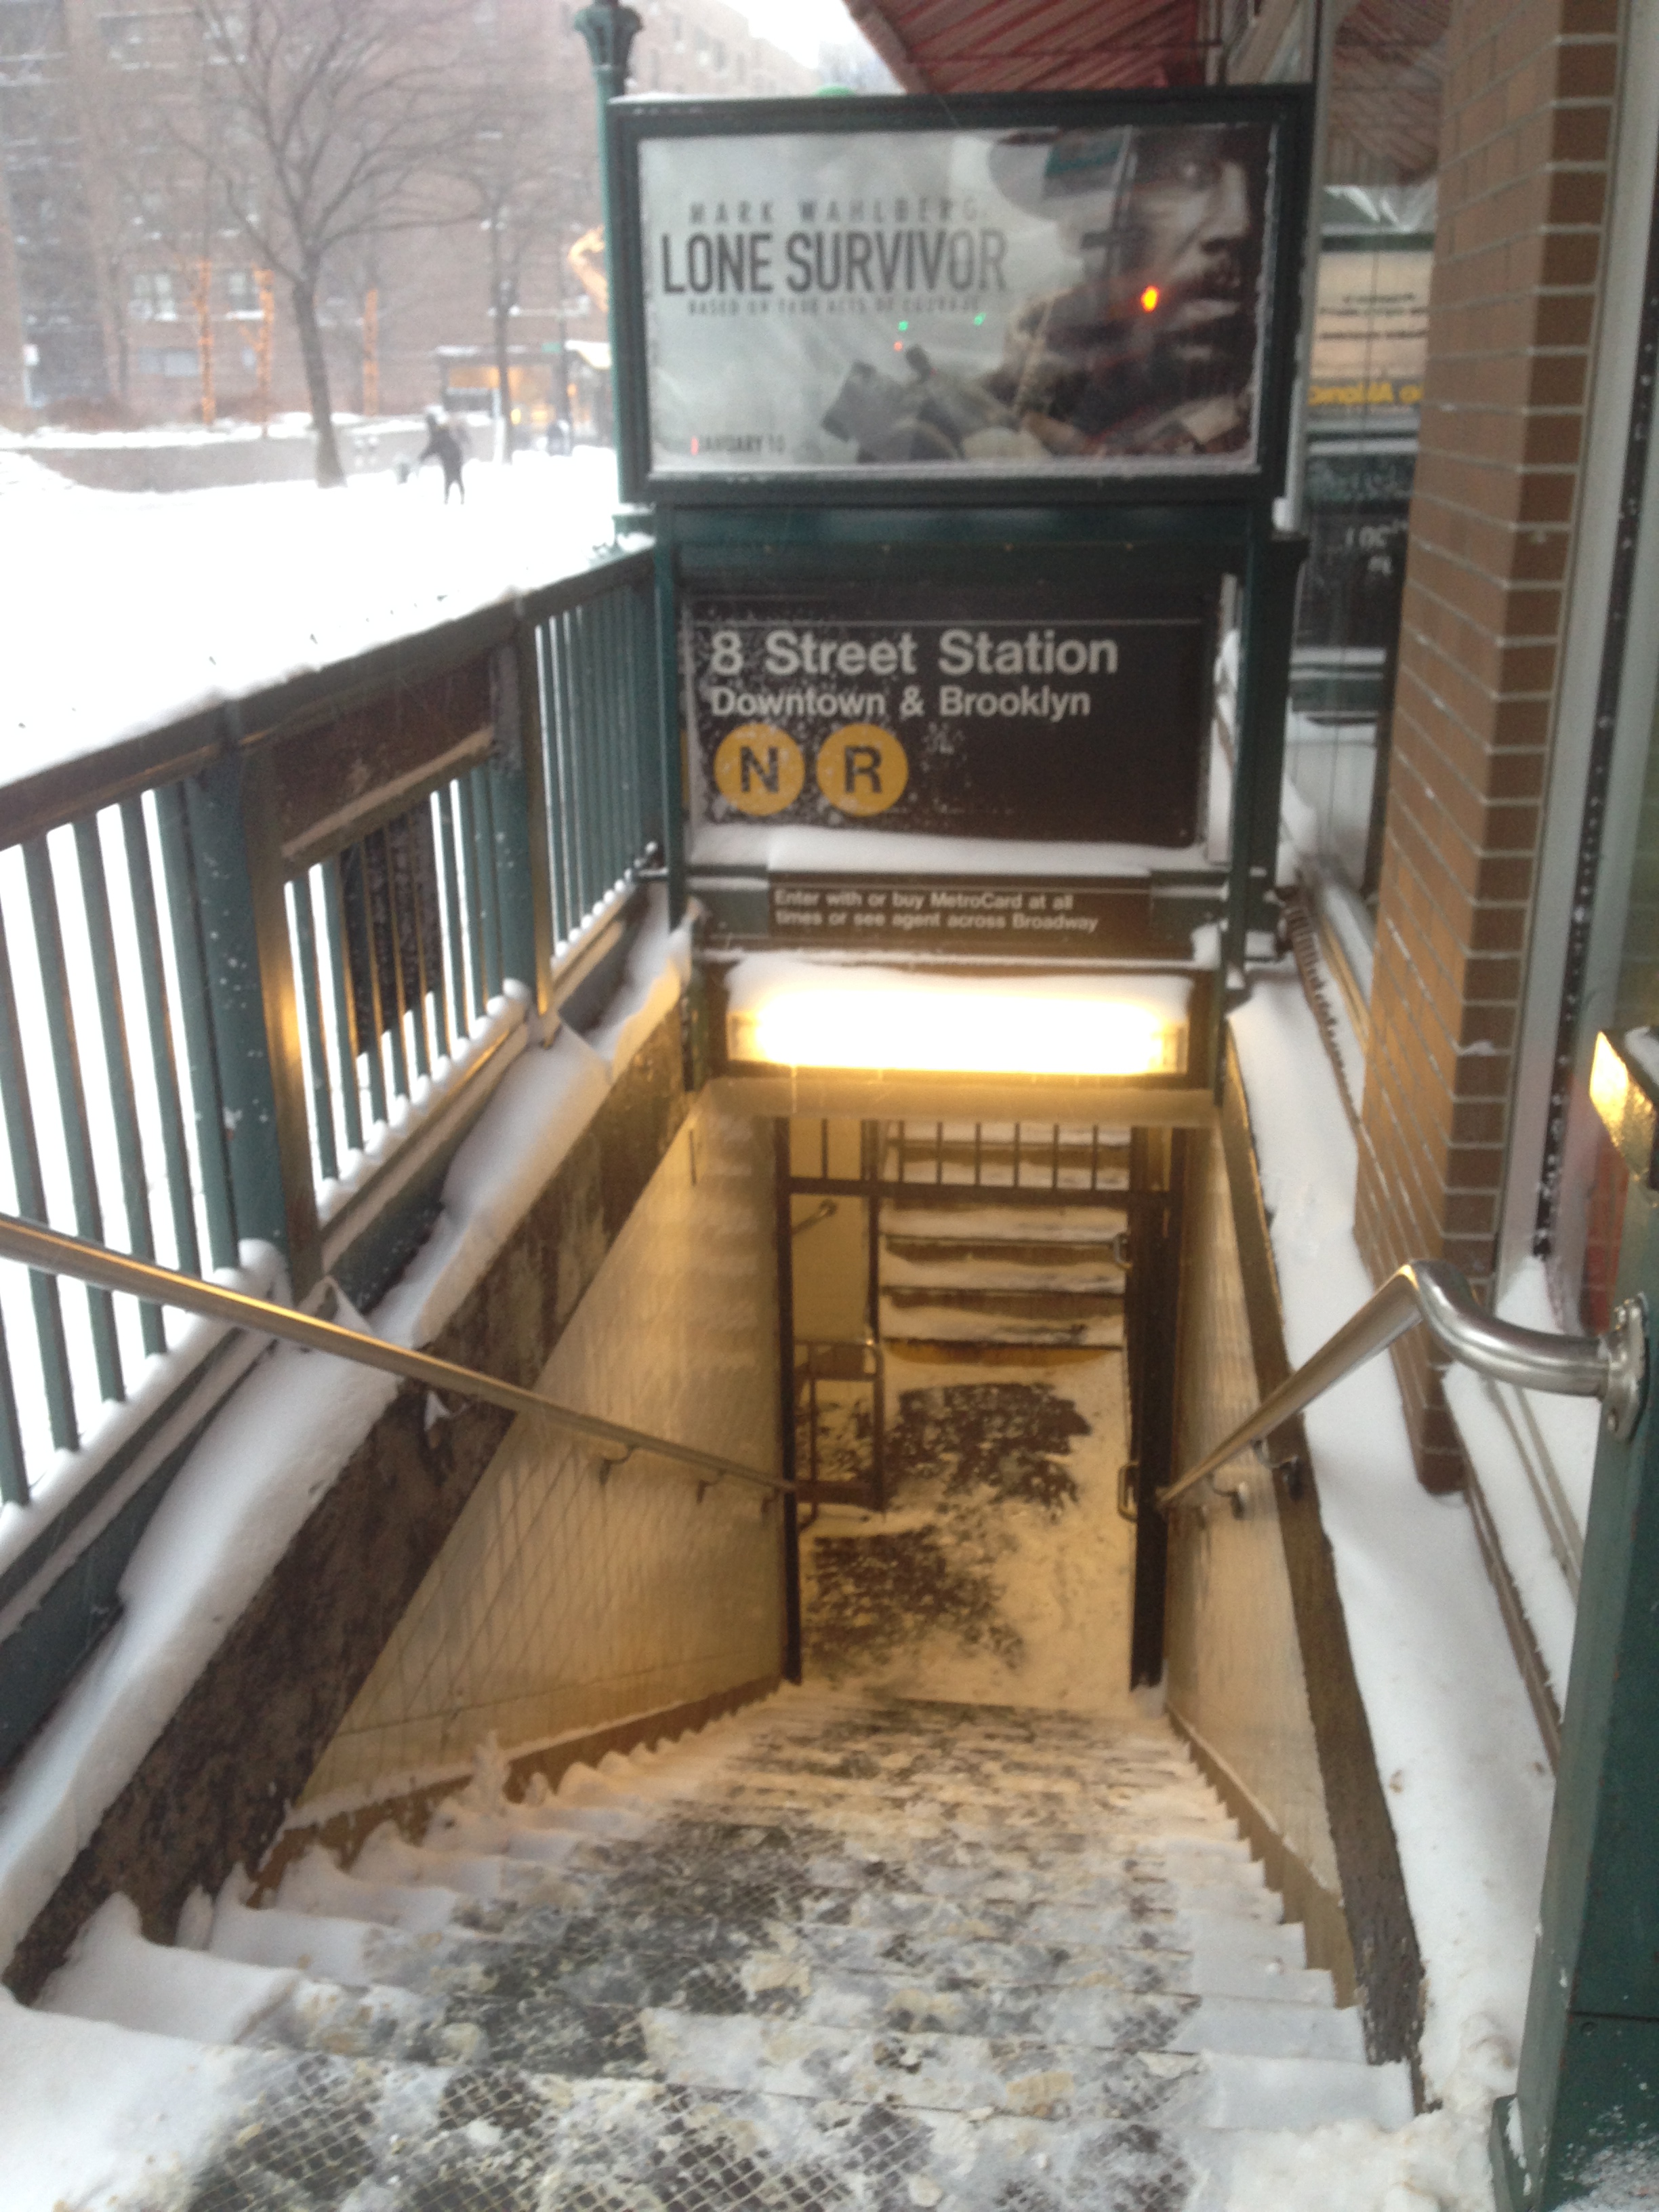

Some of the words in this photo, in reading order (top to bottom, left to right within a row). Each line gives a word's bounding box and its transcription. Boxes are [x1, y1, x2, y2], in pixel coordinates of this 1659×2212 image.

[689, 201, 774, 224] MARK
[660, 231, 774, 293] LONE
[785, 229, 1008, 293] SURVIVOR
[710, 632, 744, 677] 8
[765, 630, 918, 676] Street
[939, 628, 1119, 676] Station
[711, 687, 886, 718] Downtown
[900, 684, 924, 717] &
[939, 685, 1091, 722] Brooklyn
[739, 745, 779, 794] N
[844, 745, 882, 794] R
[775, 889, 820, 906] Enter
[826, 891, 863, 907] with
[867, 894, 887, 907] or
[892, 891, 925, 912] buy
[930, 892, 1023, 909] MetroCard
[1028, 894, 1047, 910] at
[1052, 894, 1074, 911] all
[829, 914, 847, 926] or
[853, 914, 886, 927] see
[892, 914, 941, 932] agent
[947, 916, 1006, 929] across
[1012, 912, 1099, 934] Broadway
